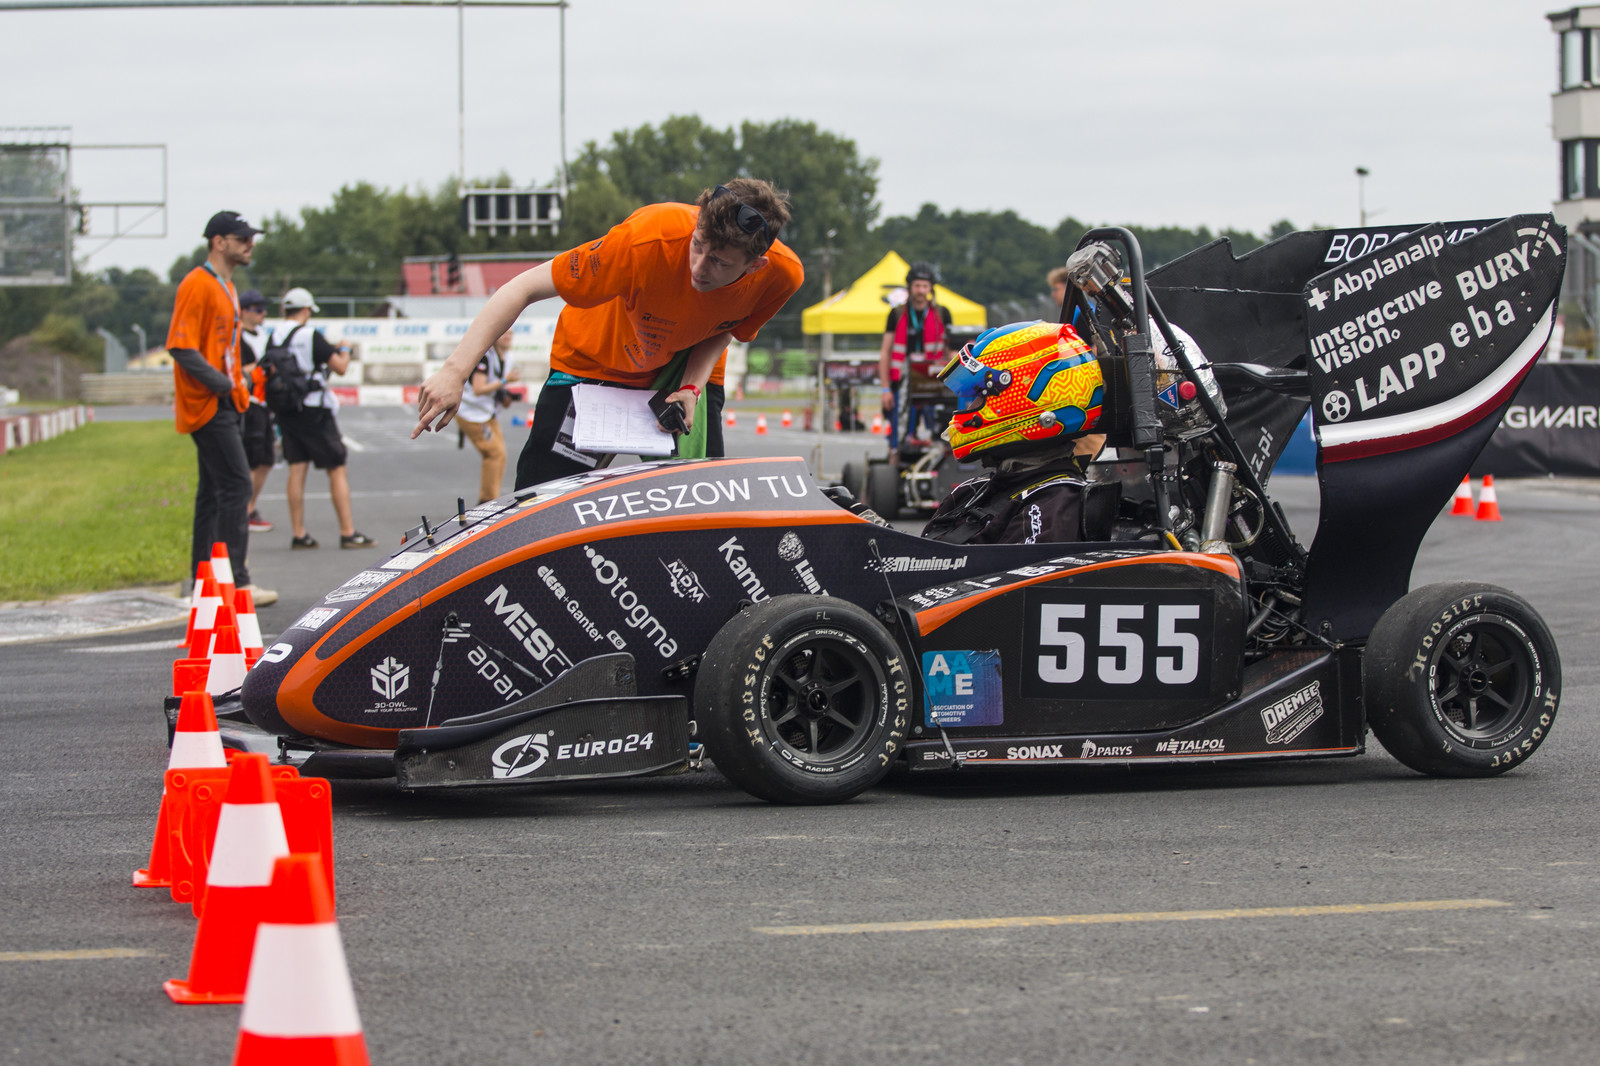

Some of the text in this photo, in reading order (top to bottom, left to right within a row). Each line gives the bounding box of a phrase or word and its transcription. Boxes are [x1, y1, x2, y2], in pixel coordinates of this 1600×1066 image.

[1334, 234, 1444, 301] Abplanalp
[1456, 241, 1532, 301] BURY
[1310, 280, 1442, 357] Interactive
[1355, 342, 1446, 412] LAPP
[1498, 405, 1600, 429] GWAR
[573, 477, 750, 525] RZESZOW
[758, 474, 808, 498] TU
[667, 561, 704, 604] MDM
[717, 536, 772, 604] Kamu
[795, 558, 820, 595] Lion
[816, 611, 831, 620] FL
[1037, 603, 1200, 685] 555
[467, 645, 523, 702] apar
[1264, 684, 1318, 730] DREMEC
[556, 732, 654, 760] EURO24
[1007, 745, 1064, 760] SONAX
[1096, 745, 1133, 757] PARYS
[1155, 738, 1225, 754] METALPOL
[805, 764, 834, 773] RACING
